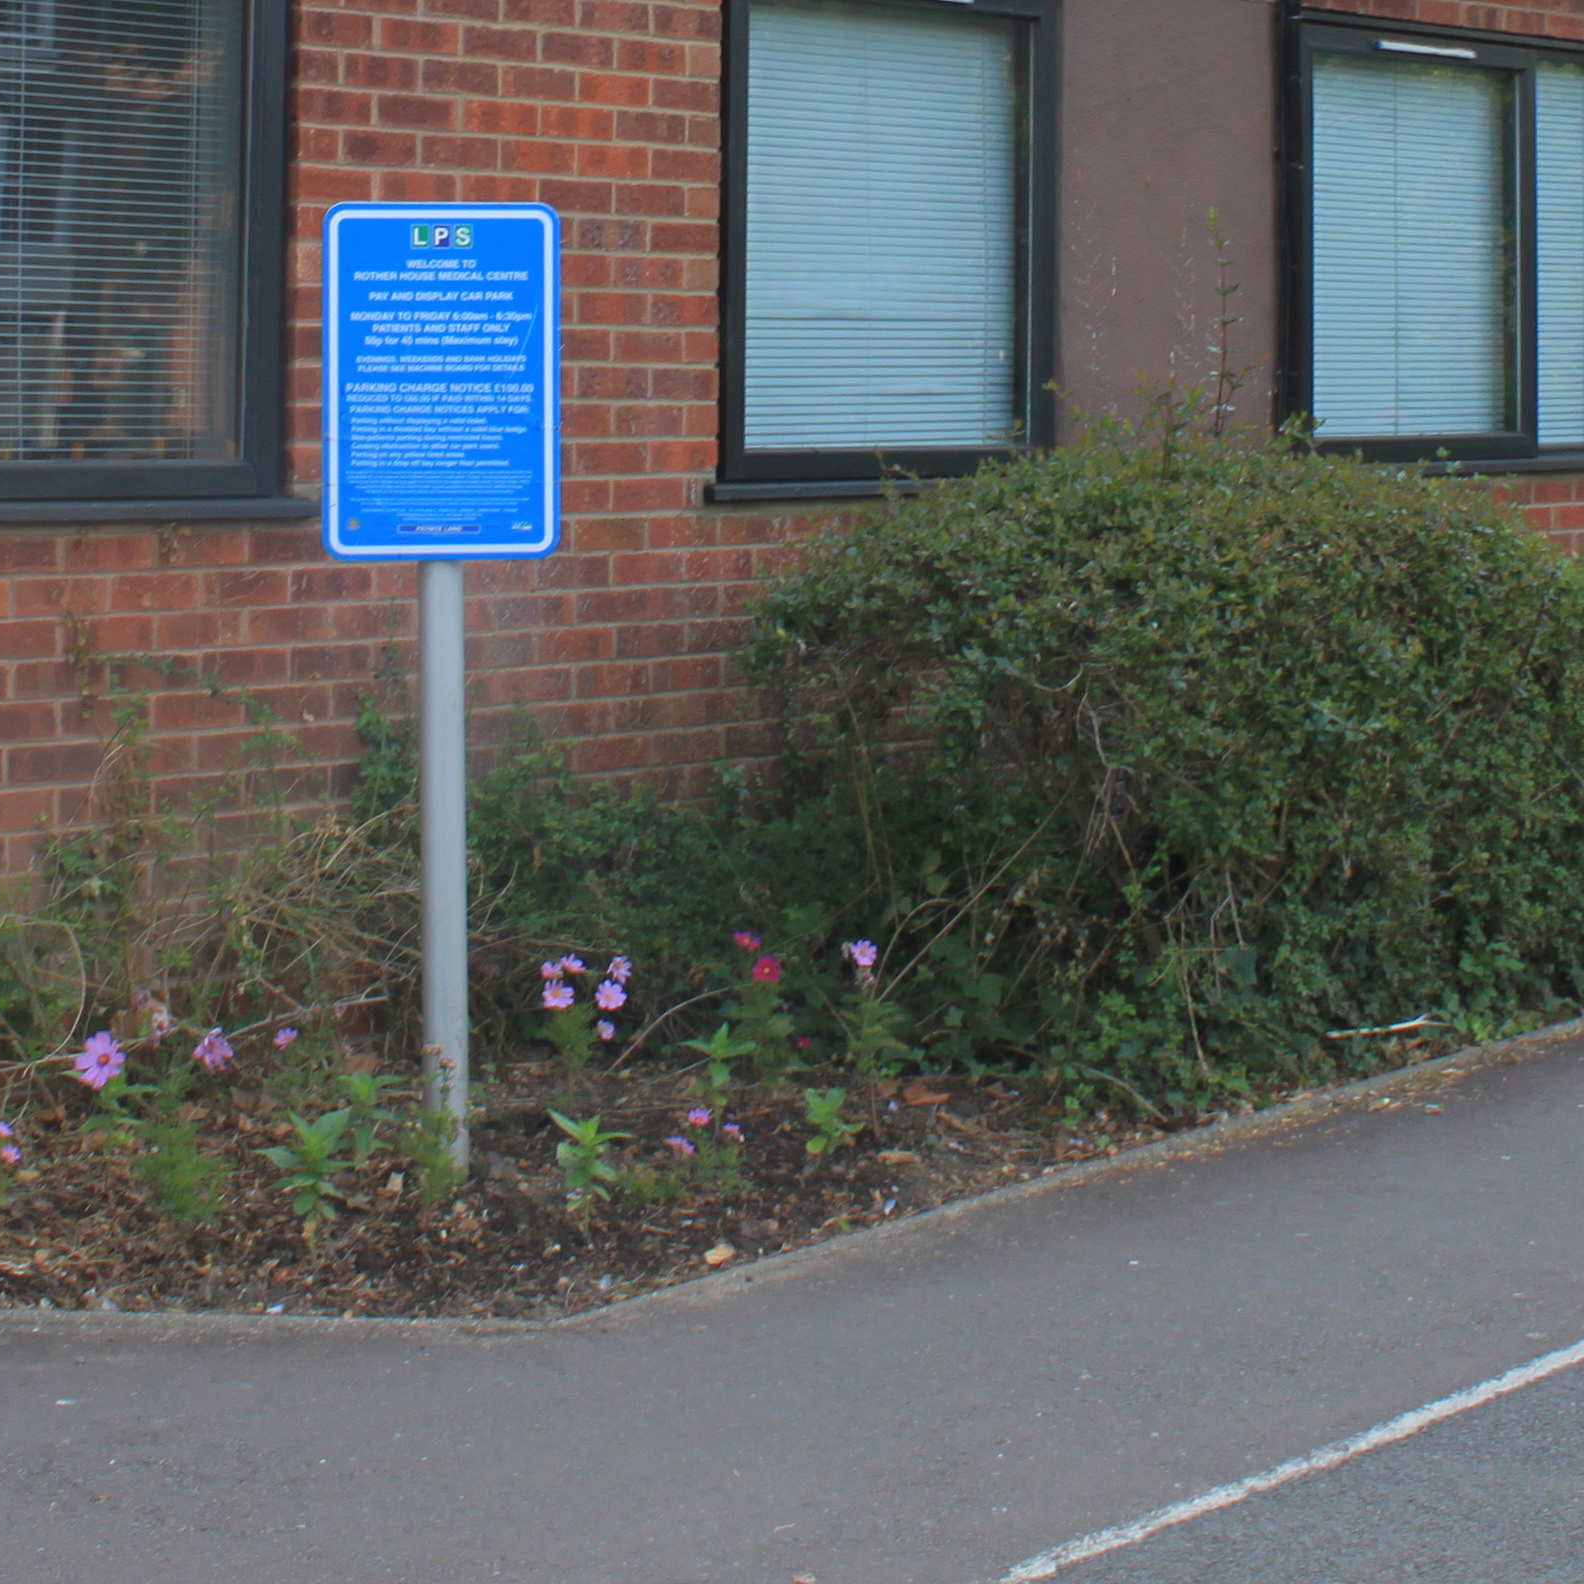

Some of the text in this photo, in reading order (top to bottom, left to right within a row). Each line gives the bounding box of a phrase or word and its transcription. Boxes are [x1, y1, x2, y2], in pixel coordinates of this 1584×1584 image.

[412, 226, 471, 248] LPS
[406, 259, 476, 269] WELCOME TO
[354, 271, 528, 281] ROTHER HOUSE MEDICAL CENTRE
[369, 291, 513, 301] PAY AND DISPLAY CAR PARK
[350, 312, 395, 321] MONDAY
[398, 312, 412, 321] TO
[414, 312, 454, 321] FRIDAY
[372, 323, 510, 333] PATIENTS AND STAFF ONLY
[385, 336, 399, 345] for
[415, 336, 439, 345] mins
[346, 383, 398, 393] PARKING
[399, 383, 448, 393] CHARGE
[450, 383, 491, 393] NOTICE
[350, 405, 390, 414] PARKING
[393, 405, 432, 414] CHARGE
